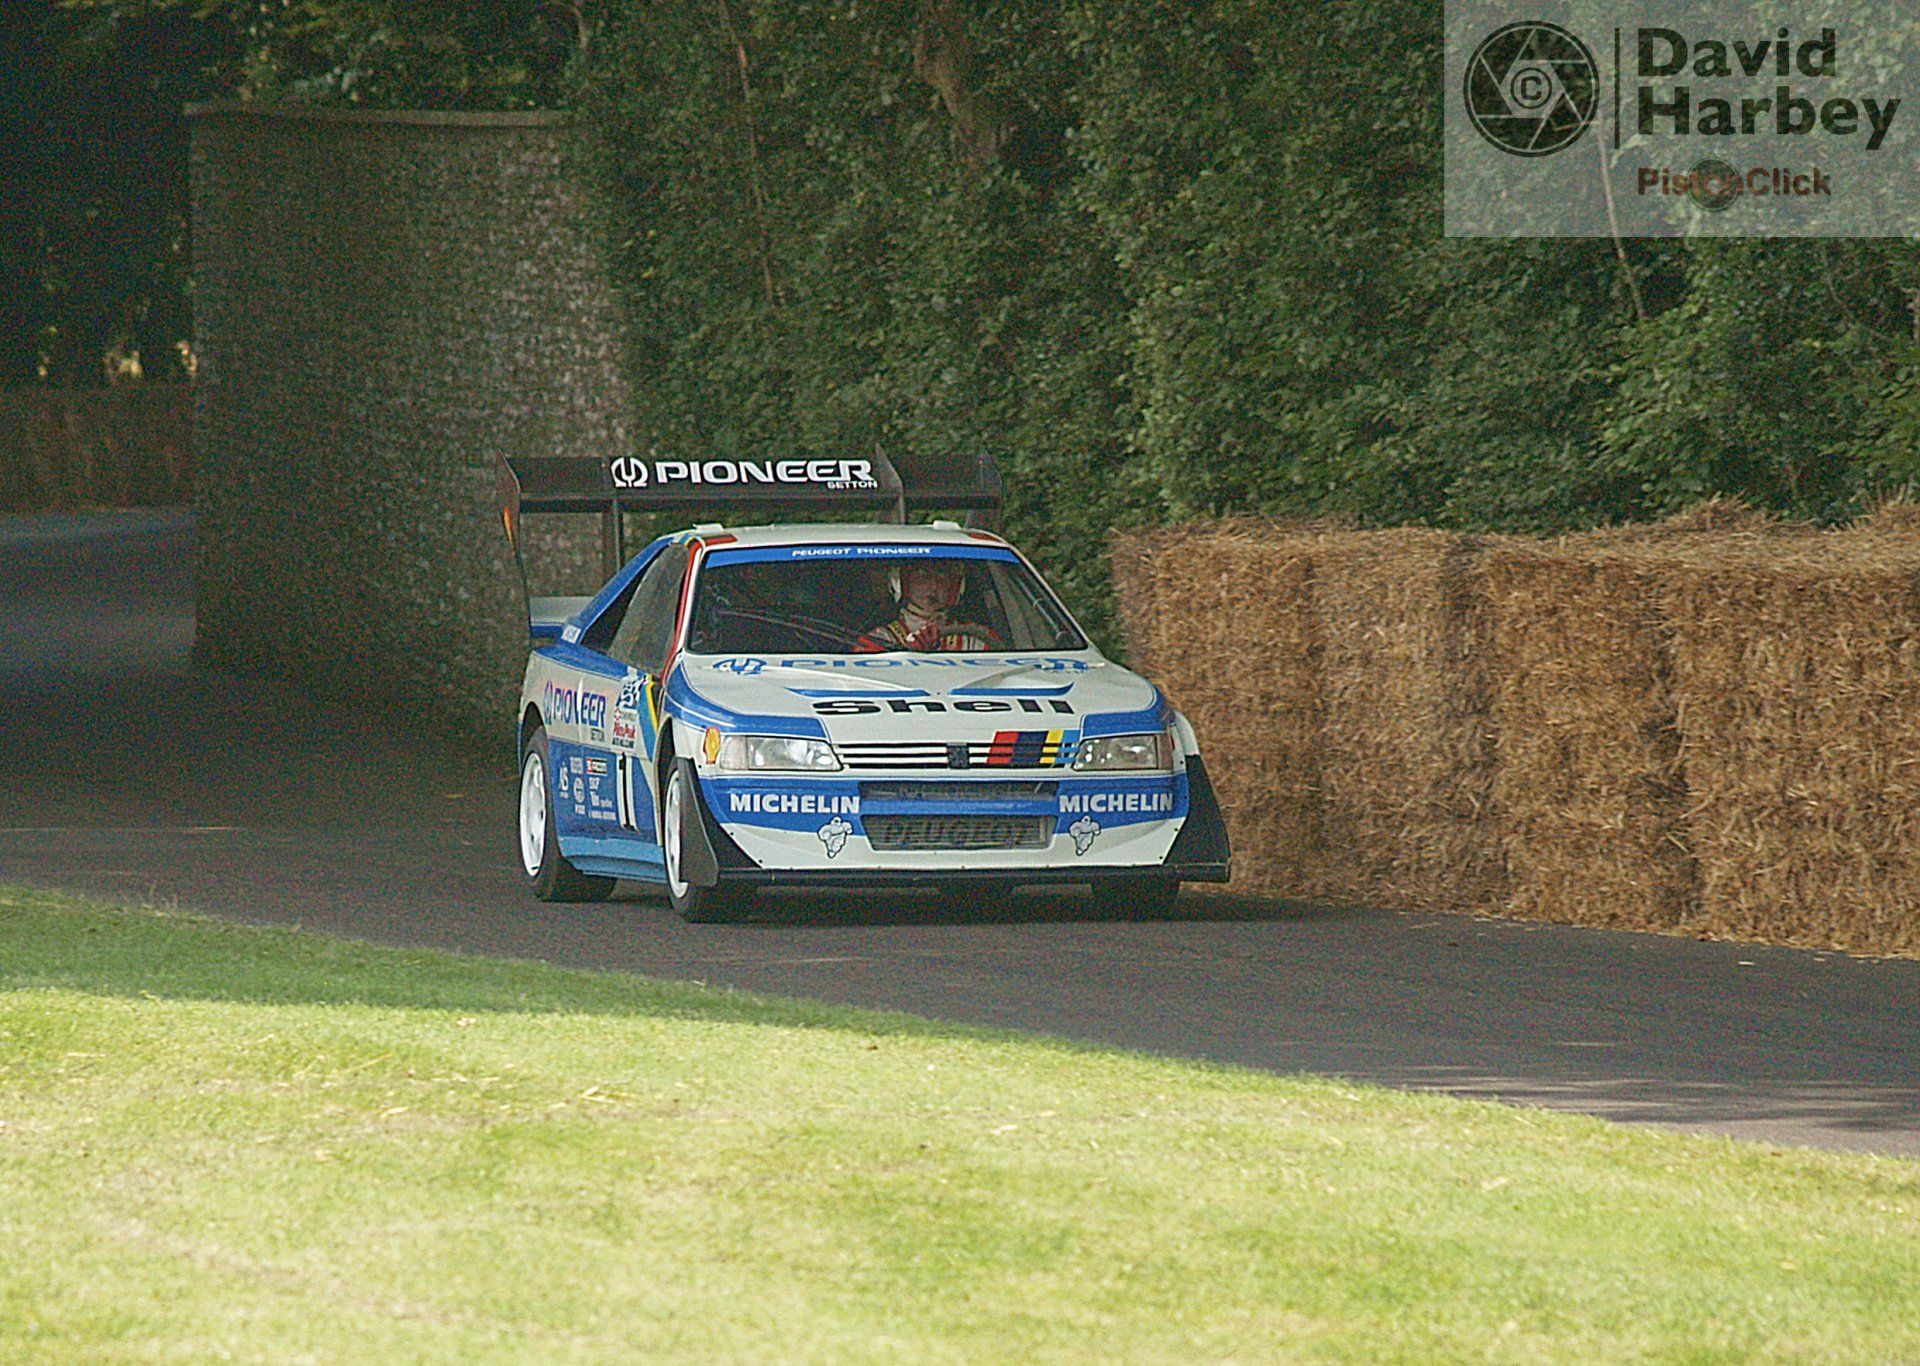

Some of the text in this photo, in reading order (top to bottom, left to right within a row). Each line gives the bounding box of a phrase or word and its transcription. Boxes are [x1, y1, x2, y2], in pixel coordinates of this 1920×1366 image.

[655, 459, 875, 484] PIONEER
[792, 547, 933, 557] PEUGEOT PIONEER
[812, 698, 1074, 715] Shell
[730, 793, 861, 814] MICHELIN
[1059, 793, 1174, 813] MICHELIN
